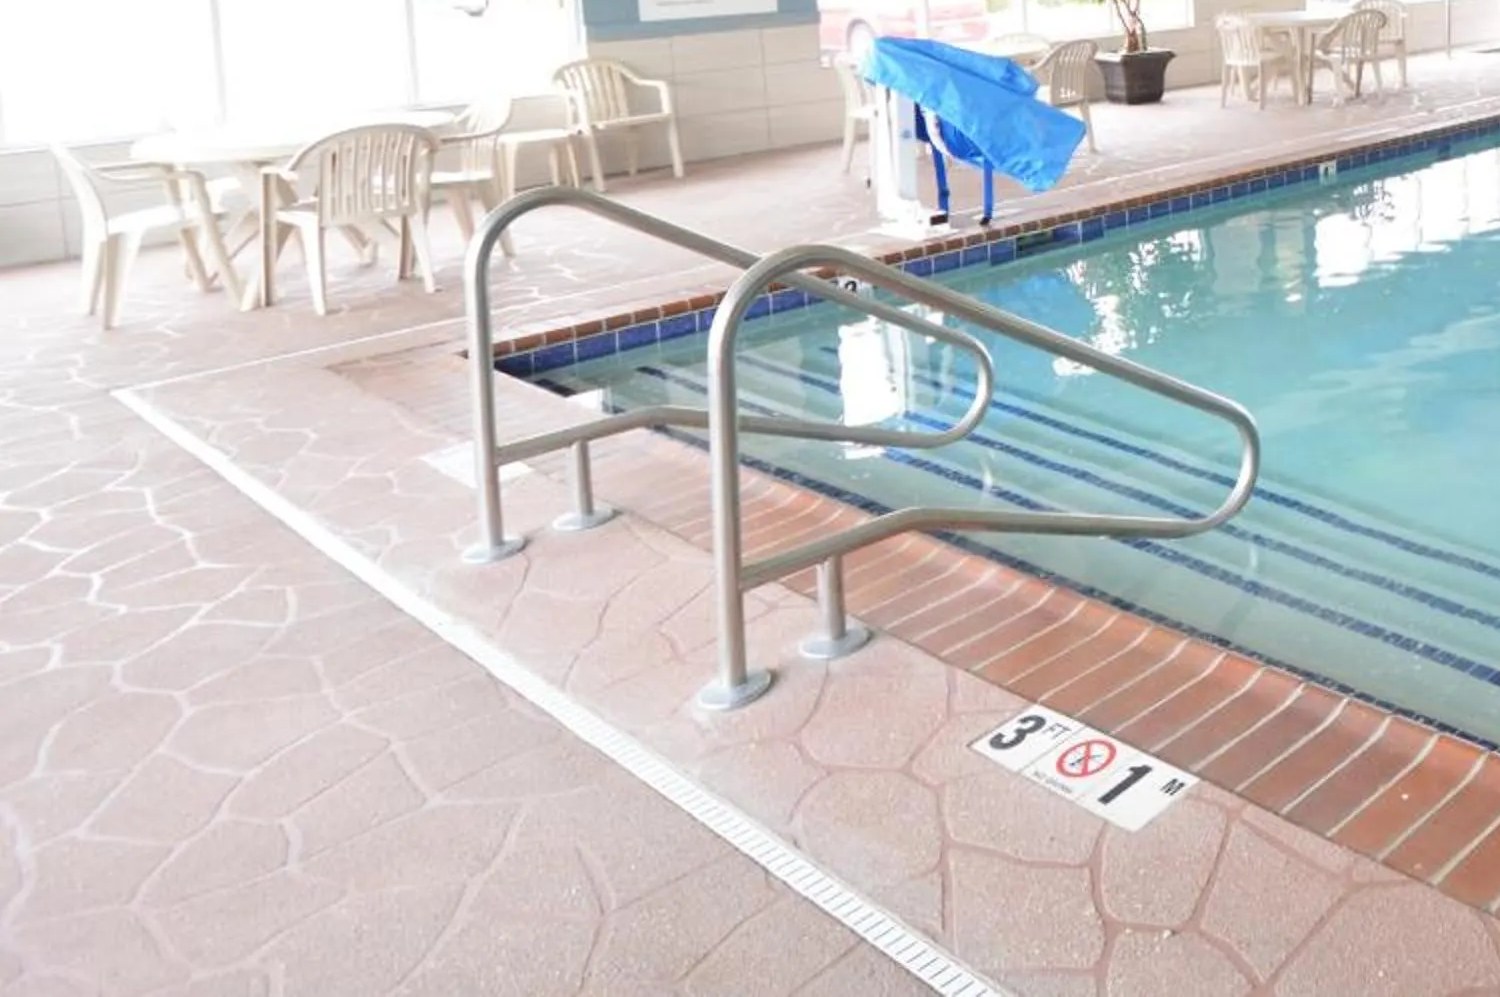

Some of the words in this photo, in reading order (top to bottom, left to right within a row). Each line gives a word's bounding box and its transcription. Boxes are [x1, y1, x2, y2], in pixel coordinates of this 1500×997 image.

[988, 714, 1047, 751] 3
[1046, 722, 1072, 740] FT
[1097, 763, 1154, 806] 1
[1160, 777, 1186, 797] M
